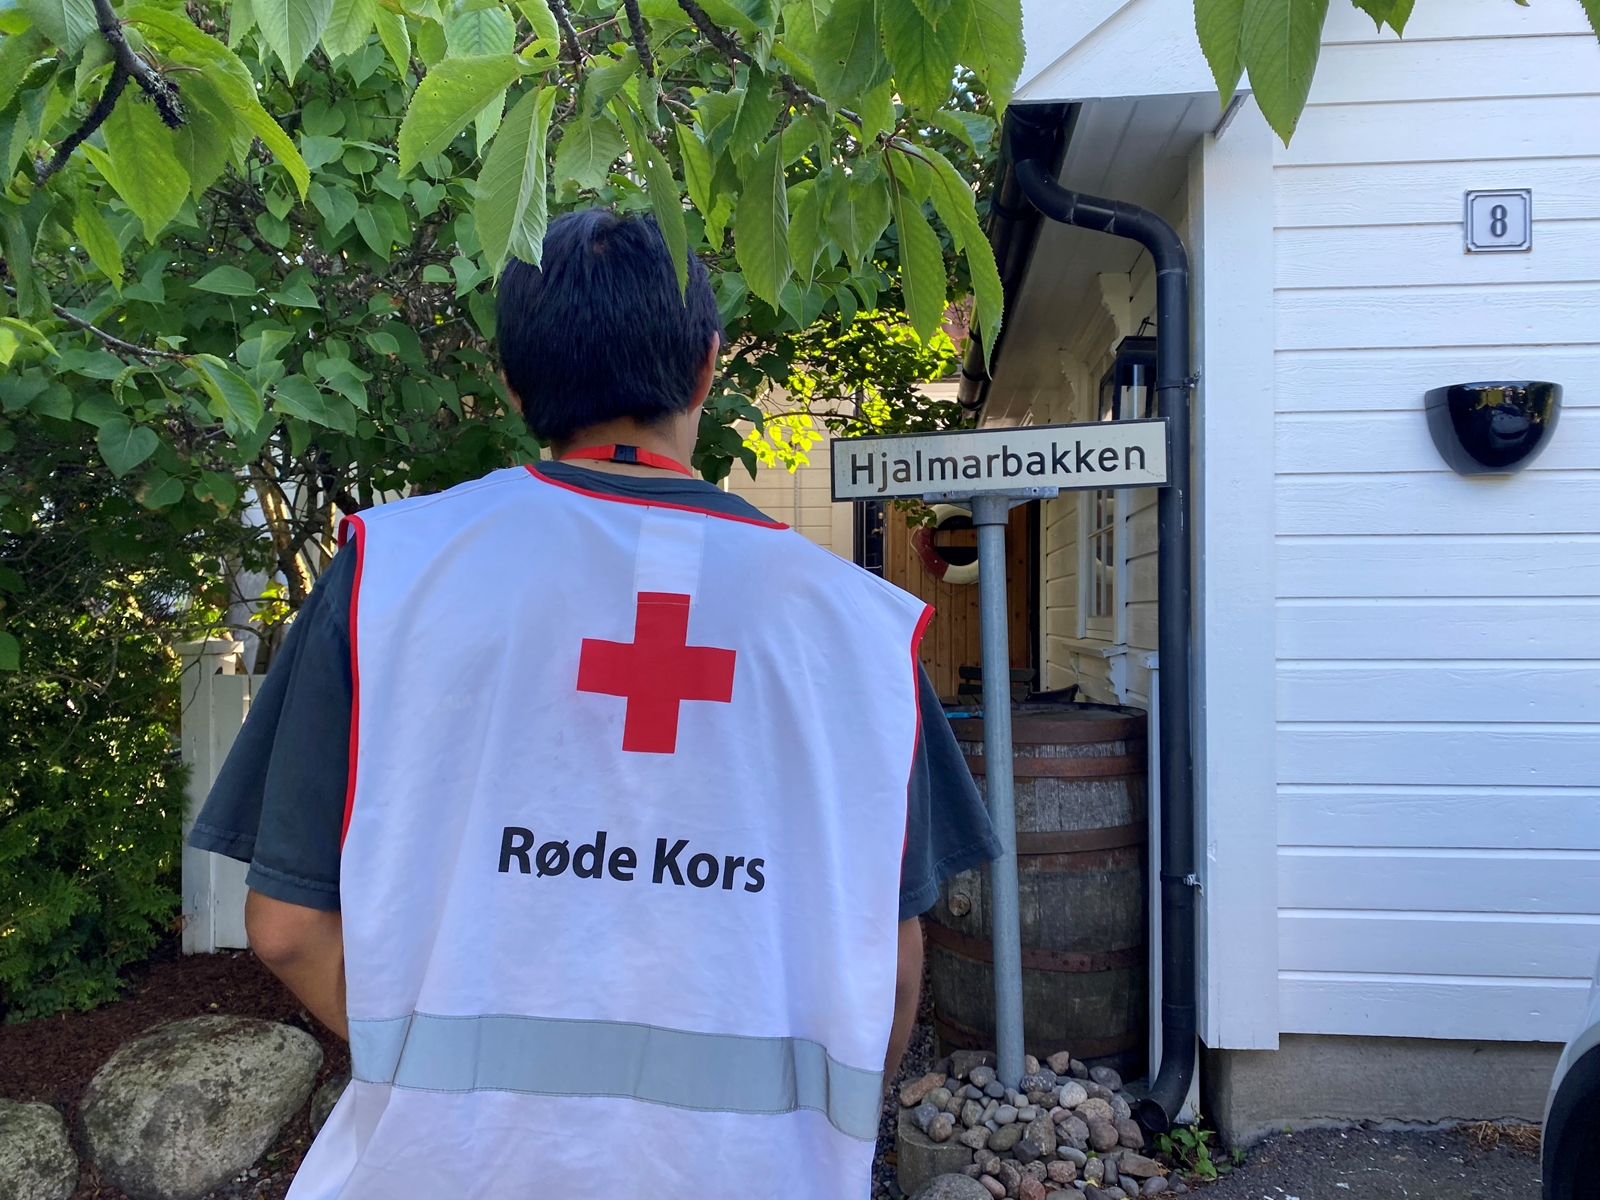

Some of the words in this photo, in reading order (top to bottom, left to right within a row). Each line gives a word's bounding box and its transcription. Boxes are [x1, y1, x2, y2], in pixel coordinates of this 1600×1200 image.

[1490, 204, 1508, 238] 8
[850, 440, 1146, 492] Hjalmarbakken
[498, 827, 638, 882] Røde
[652, 838, 765, 893] Kors
